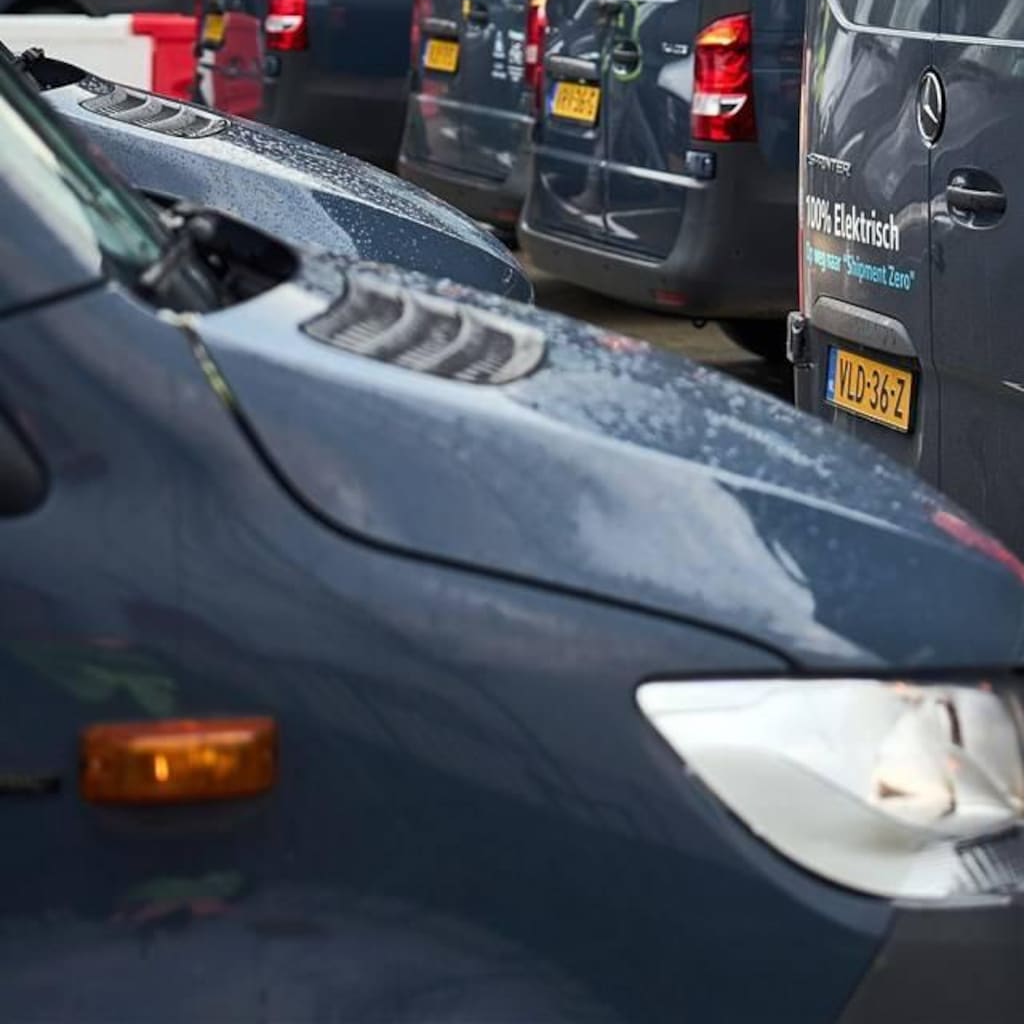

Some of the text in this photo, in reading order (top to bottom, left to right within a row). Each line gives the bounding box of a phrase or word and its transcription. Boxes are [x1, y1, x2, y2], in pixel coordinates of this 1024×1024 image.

[806, 194, 900, 252] 100% Elektrisch
[840, 358, 906, 420] VLD-36-Z
